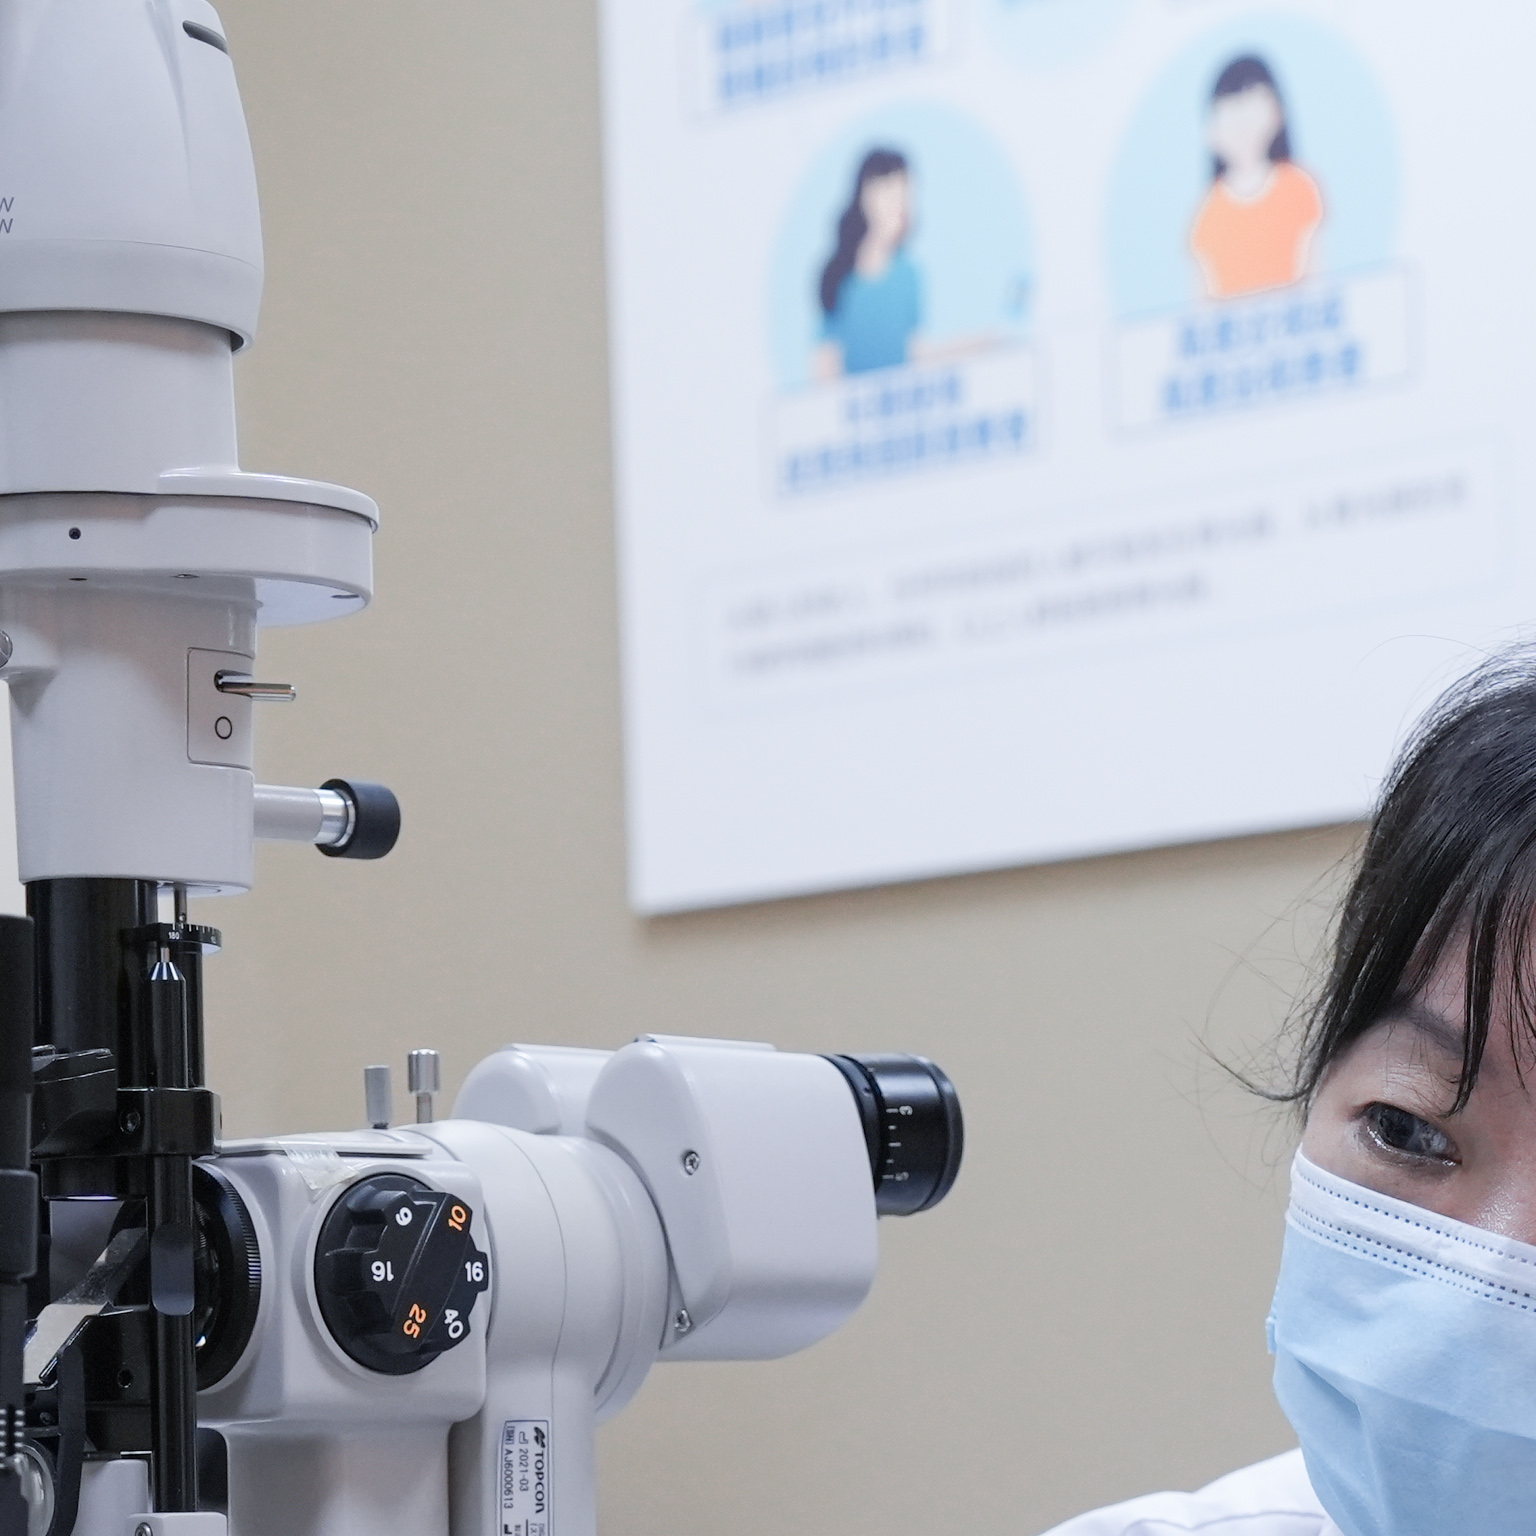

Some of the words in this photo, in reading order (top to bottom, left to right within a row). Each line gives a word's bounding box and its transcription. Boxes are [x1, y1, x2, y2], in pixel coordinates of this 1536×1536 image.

[168, 931, 180, 940] 180
[447, 1205, 467, 1232] 10
[370, 1261, 395, 1282] 16
[465, 1261, 484, 1282] 16
[402, 1303, 427, 1339] 25
[444, 1308, 464, 1339] 40
[503, 1448, 514, 1510] AJ6000613
[519, 1448, 529, 1492] 2021-03
[535, 1450, 545, 1514] TOPCON
